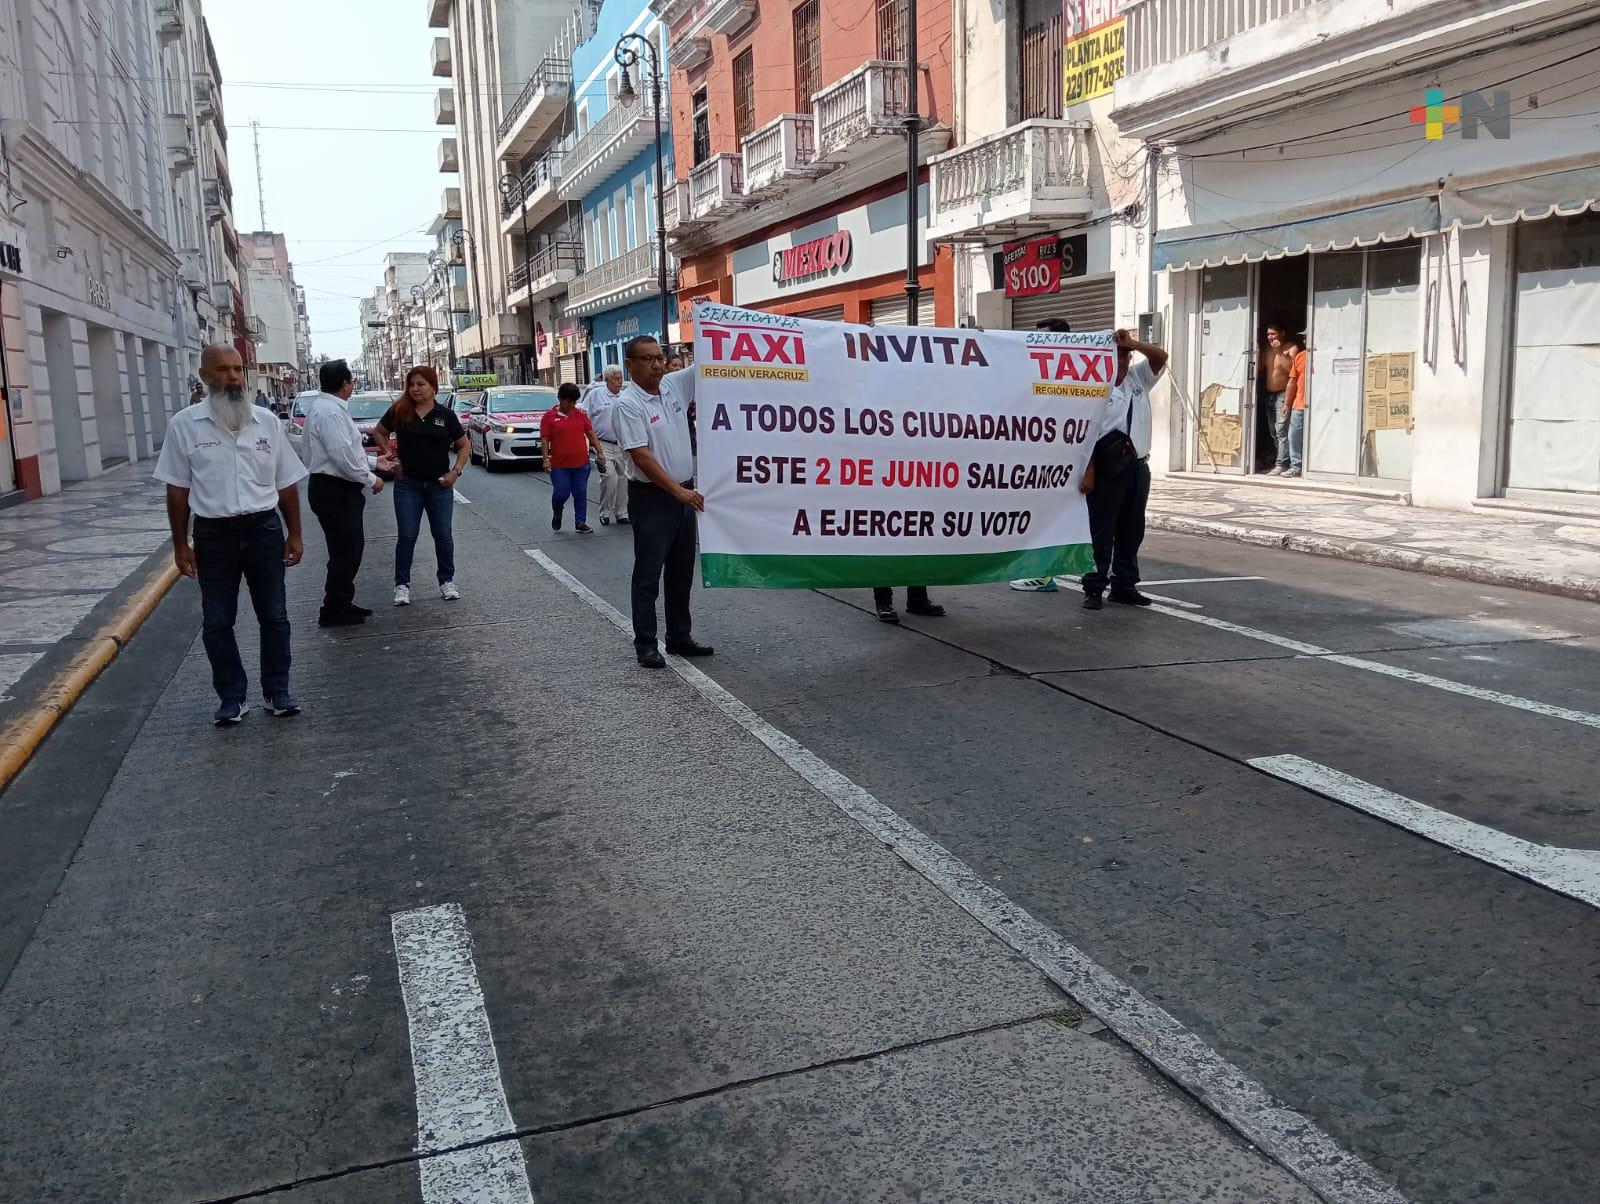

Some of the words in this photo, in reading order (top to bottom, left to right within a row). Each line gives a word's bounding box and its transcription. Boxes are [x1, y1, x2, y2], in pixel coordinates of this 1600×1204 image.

[1067, 36, 1101, 71] PLANTA
[1103, 26, 1124, 56] ALTA
[1066, 71, 1083, 101] 229
[783, 230, 850, 280] MEXICO
[1010, 264, 1051, 292] $100
[702, 329, 806, 365] TAXI
[843, 331, 989, 367] INVITA
[705, 368, 747, 379] REGIÓN
[748, 369, 805, 381] VERACRUZ
[1029, 351, 1114, 383] TAXI
[1035, 385, 1068, 396] REGIÓN
[711, 403, 732, 431] A
[740, 403, 835, 434] TODOS
[844, 408, 894, 436] LOS
[902, 411, 1057, 443] CIUDADANOS
[1063, 418, 1090, 445] QU
[736, 455, 806, 485] ESTE
[815, 457, 831, 485] 2
[840, 458, 873, 486] DE
[882, 460, 959, 489] JUNIO
[967, 462, 1073, 490] SALGAMOS
[792, 508, 812, 536] A
[820, 509, 934, 537] EJERCER
[942, 510, 973, 537] SU
[980, 510, 1031, 536] VOTO
